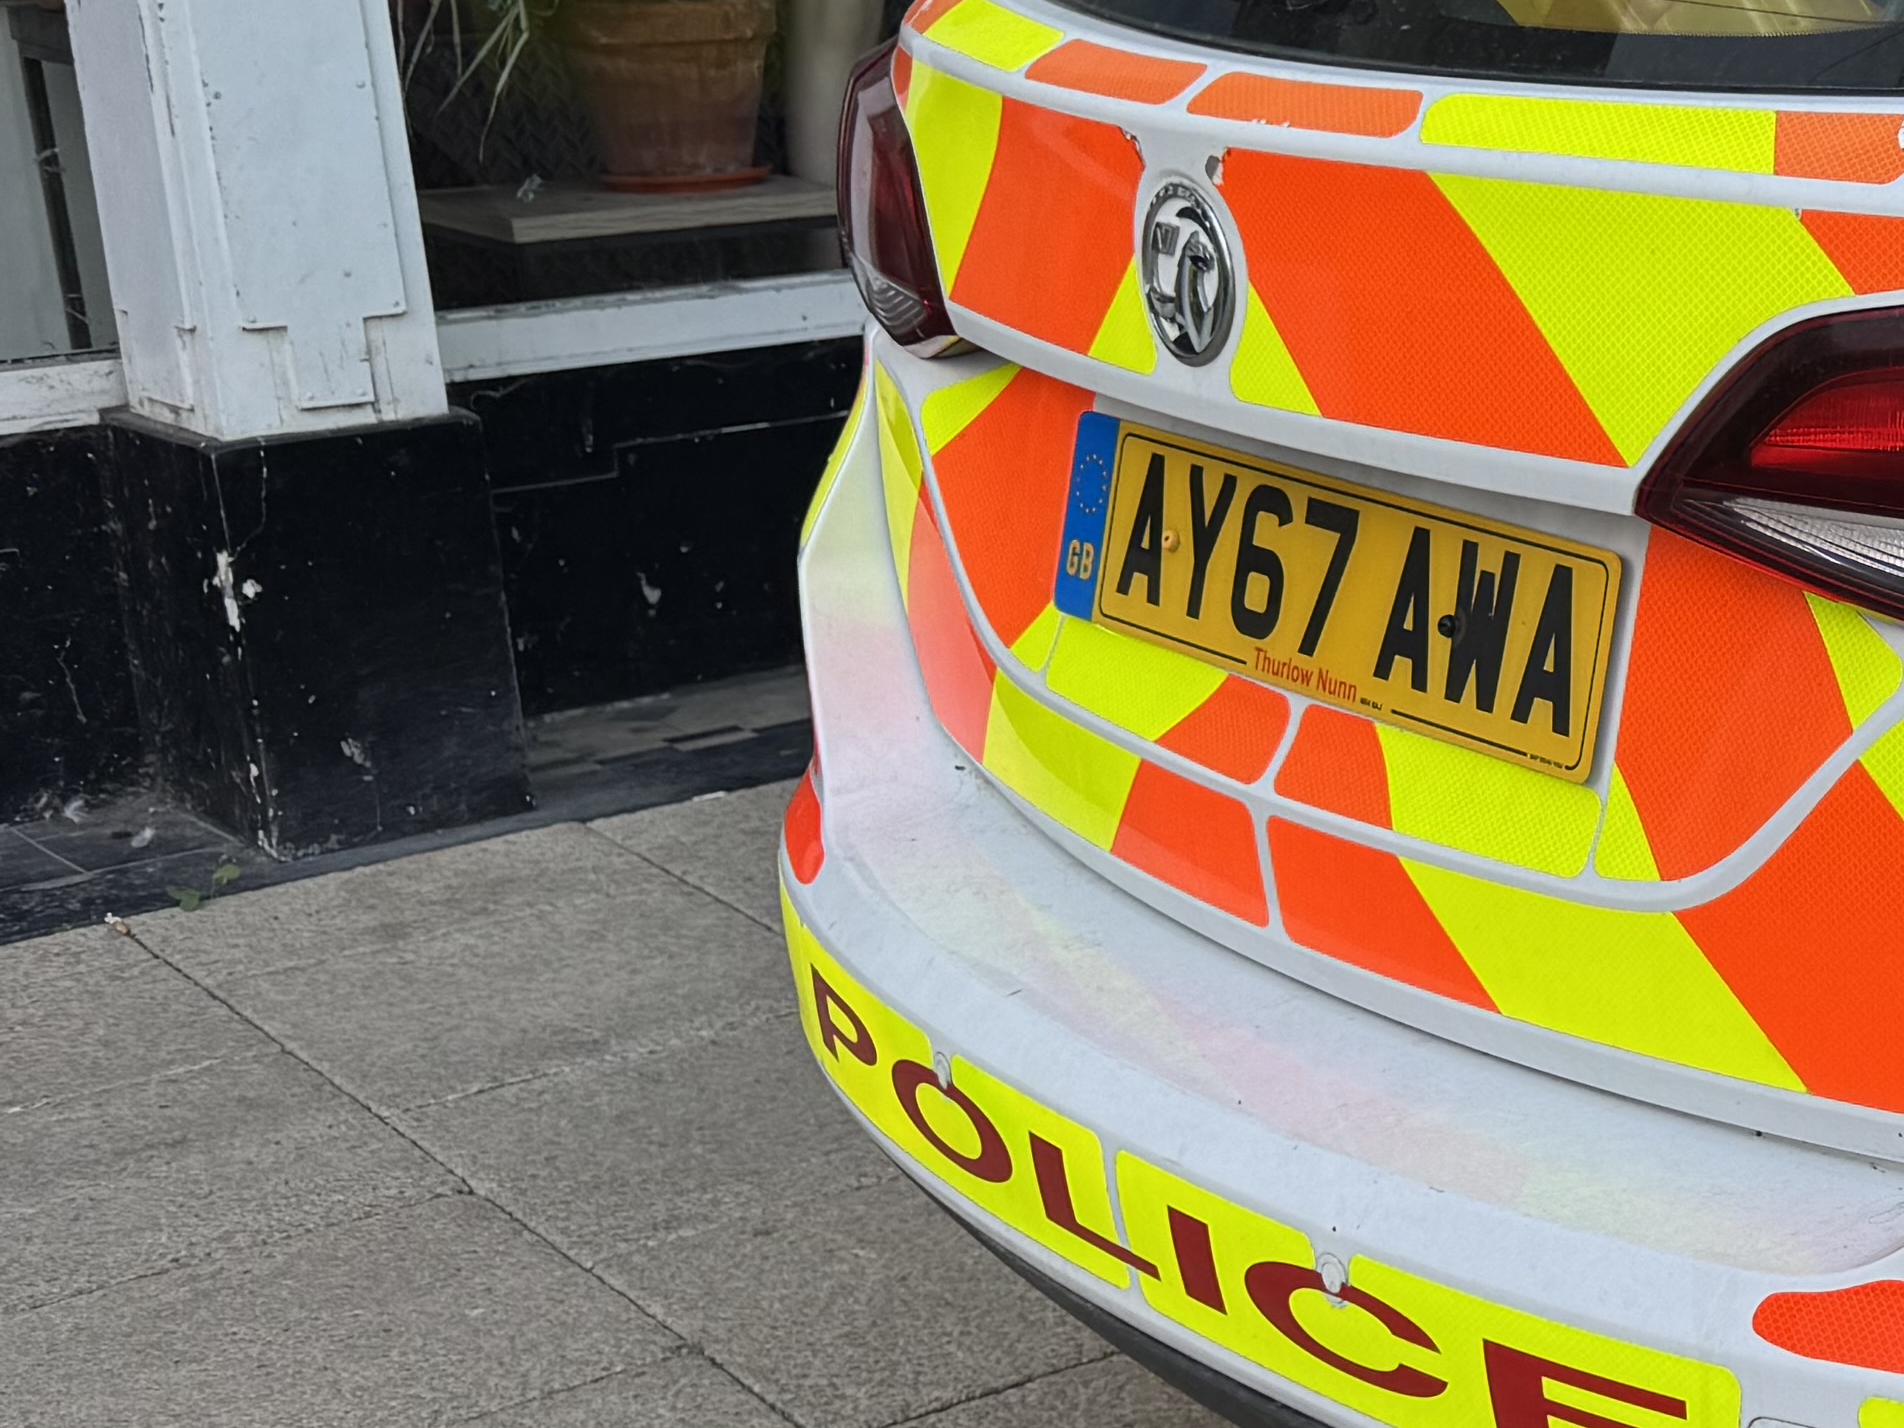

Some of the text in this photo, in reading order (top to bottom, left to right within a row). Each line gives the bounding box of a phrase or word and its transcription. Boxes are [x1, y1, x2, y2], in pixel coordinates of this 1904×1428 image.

[1066, 538, 1093, 581] GB
[1116, 452, 1575, 739] AY67 AWA
[1253, 646, 1358, 703] Thurlow Nunn
